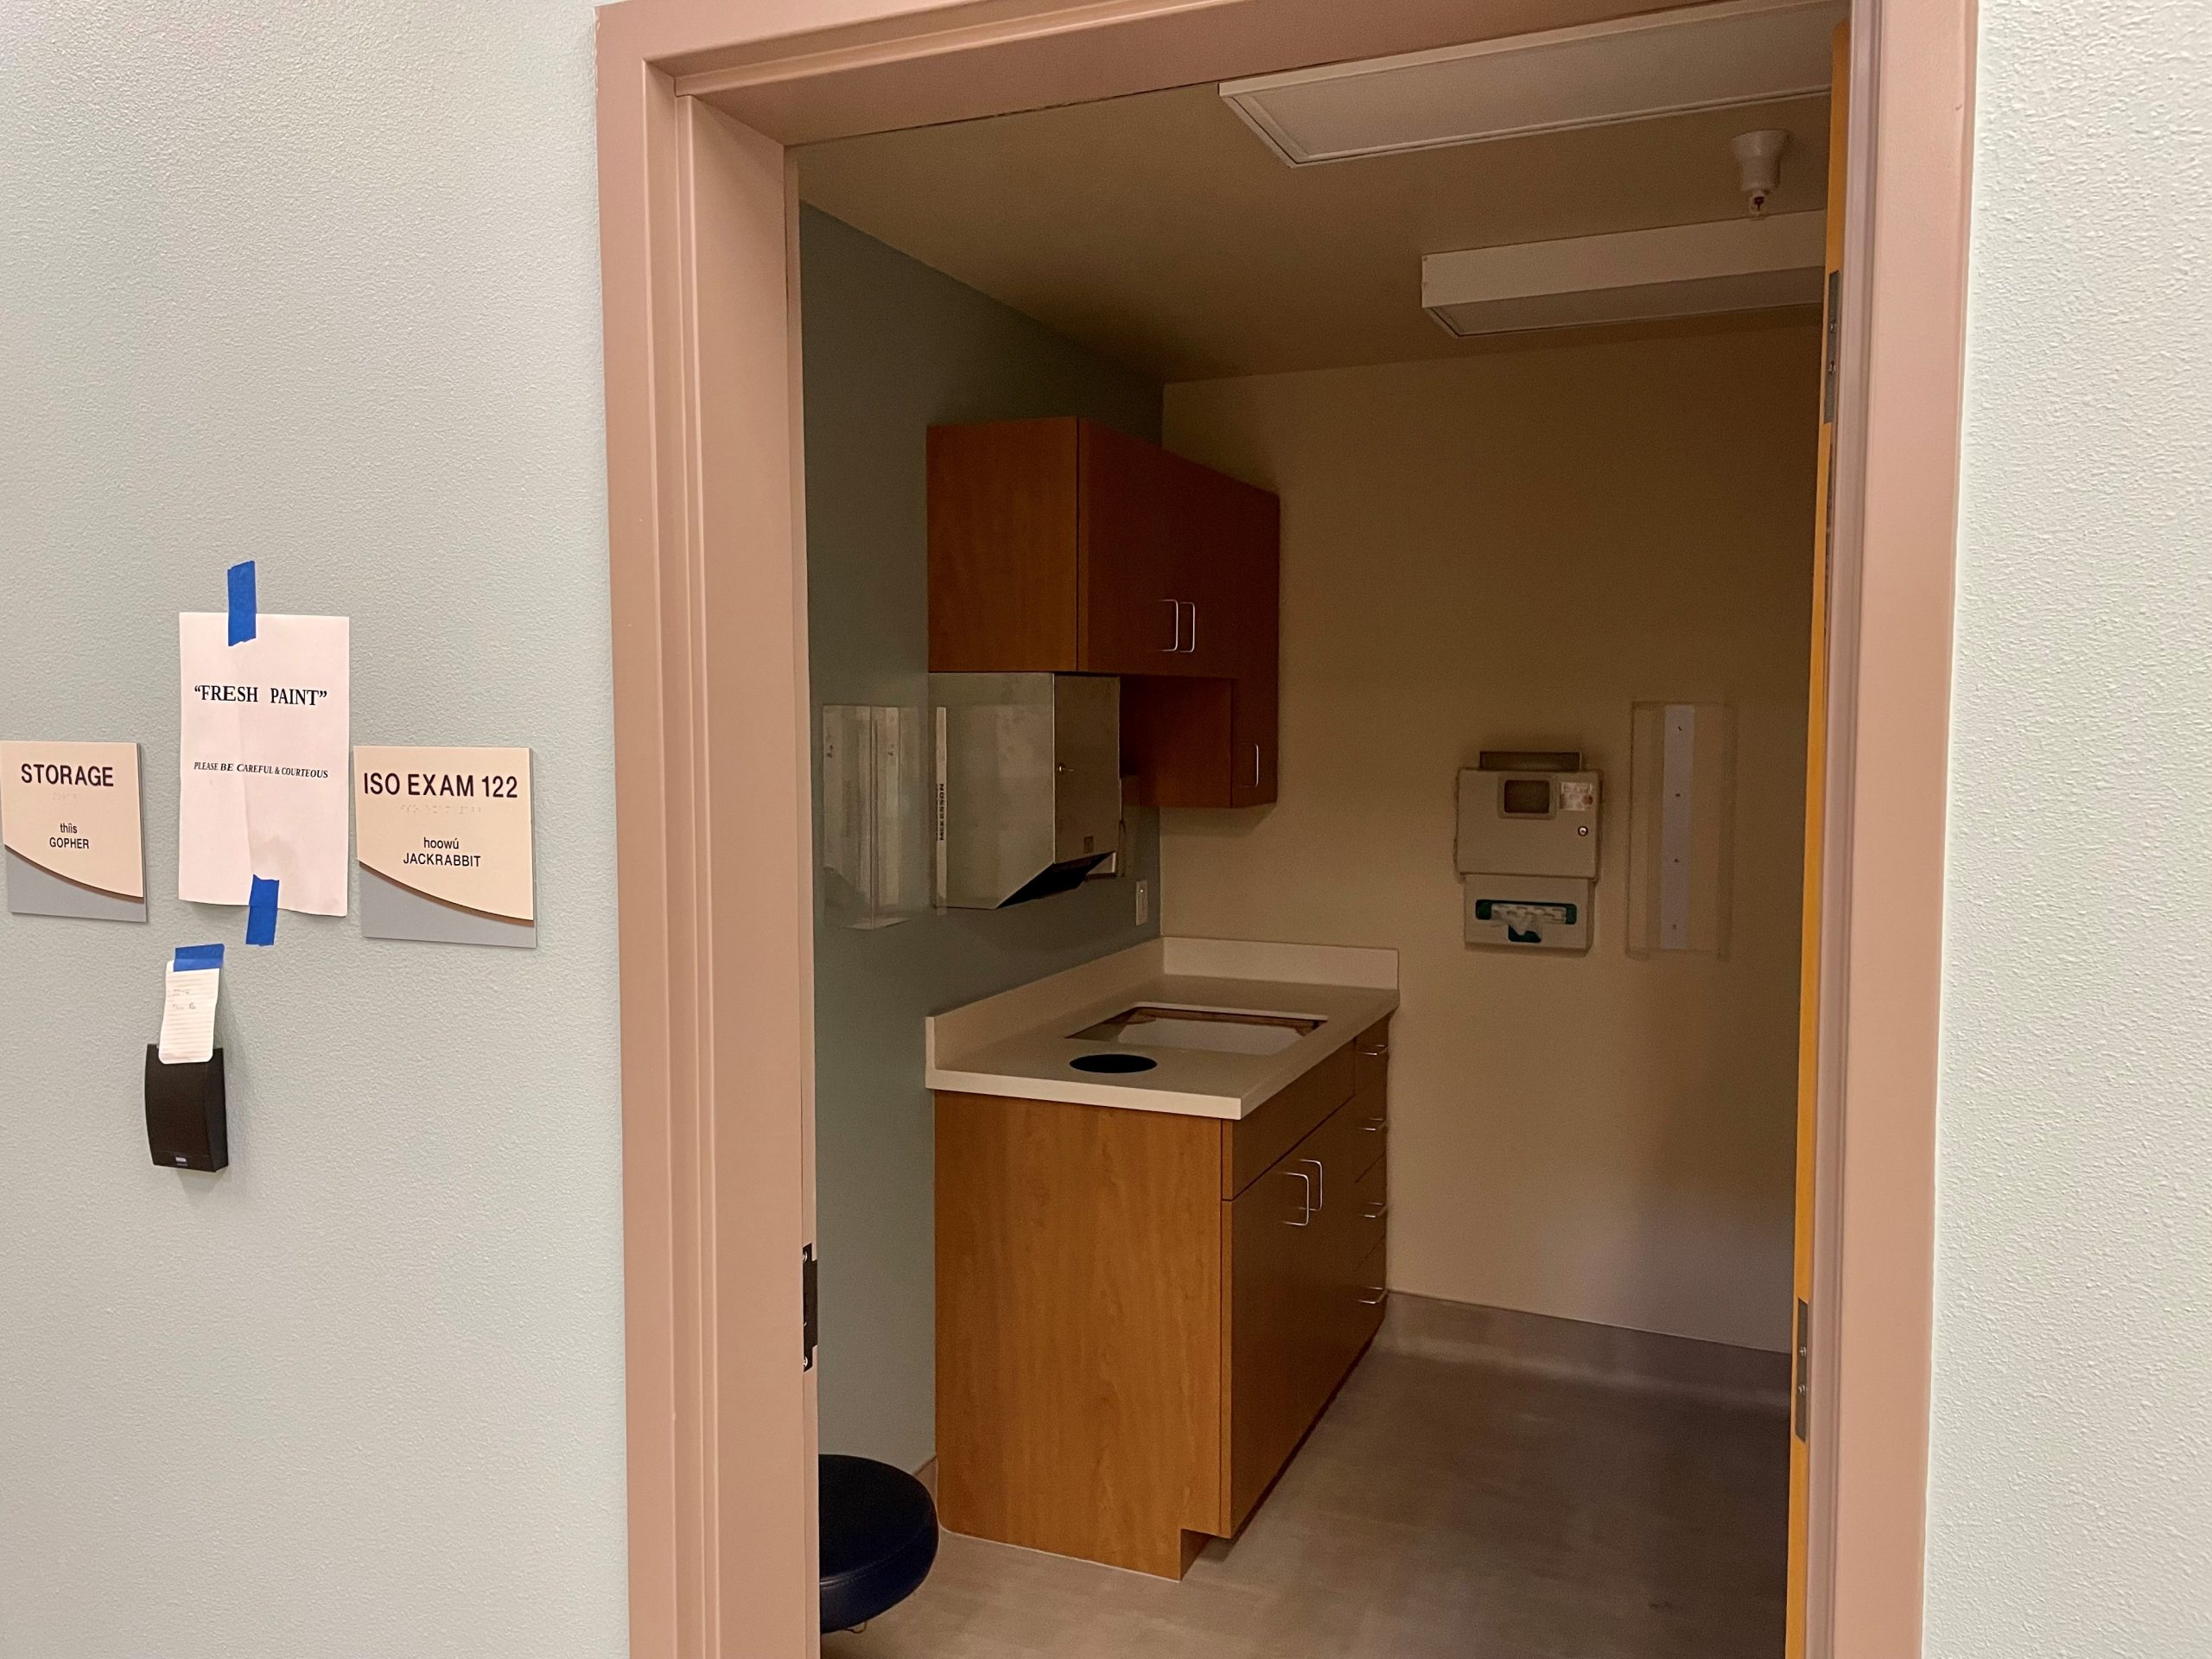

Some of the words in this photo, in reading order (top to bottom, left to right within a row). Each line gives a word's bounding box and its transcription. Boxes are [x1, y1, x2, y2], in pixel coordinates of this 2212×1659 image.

[194, 685, 258, 702] “FRESH
[270, 688, 327, 706] PAINT”
[21, 763, 114, 786] STORAGE
[194, 761, 219, 771] PLEASE
[219, 763, 234, 772] BE
[236, 764, 273, 774] CAREFUL
[274, 766, 280, 775] &
[281, 766, 328, 779] COURTEOUS
[364, 772, 401, 796] ISO
[407, 773, 474, 798] EXAM
[481, 775, 518, 798] 122
[49, 836, 90, 849] GOPHER
[423, 836, 460, 849] hoowú
[403, 852, 481, 868] JACKRABBIT
